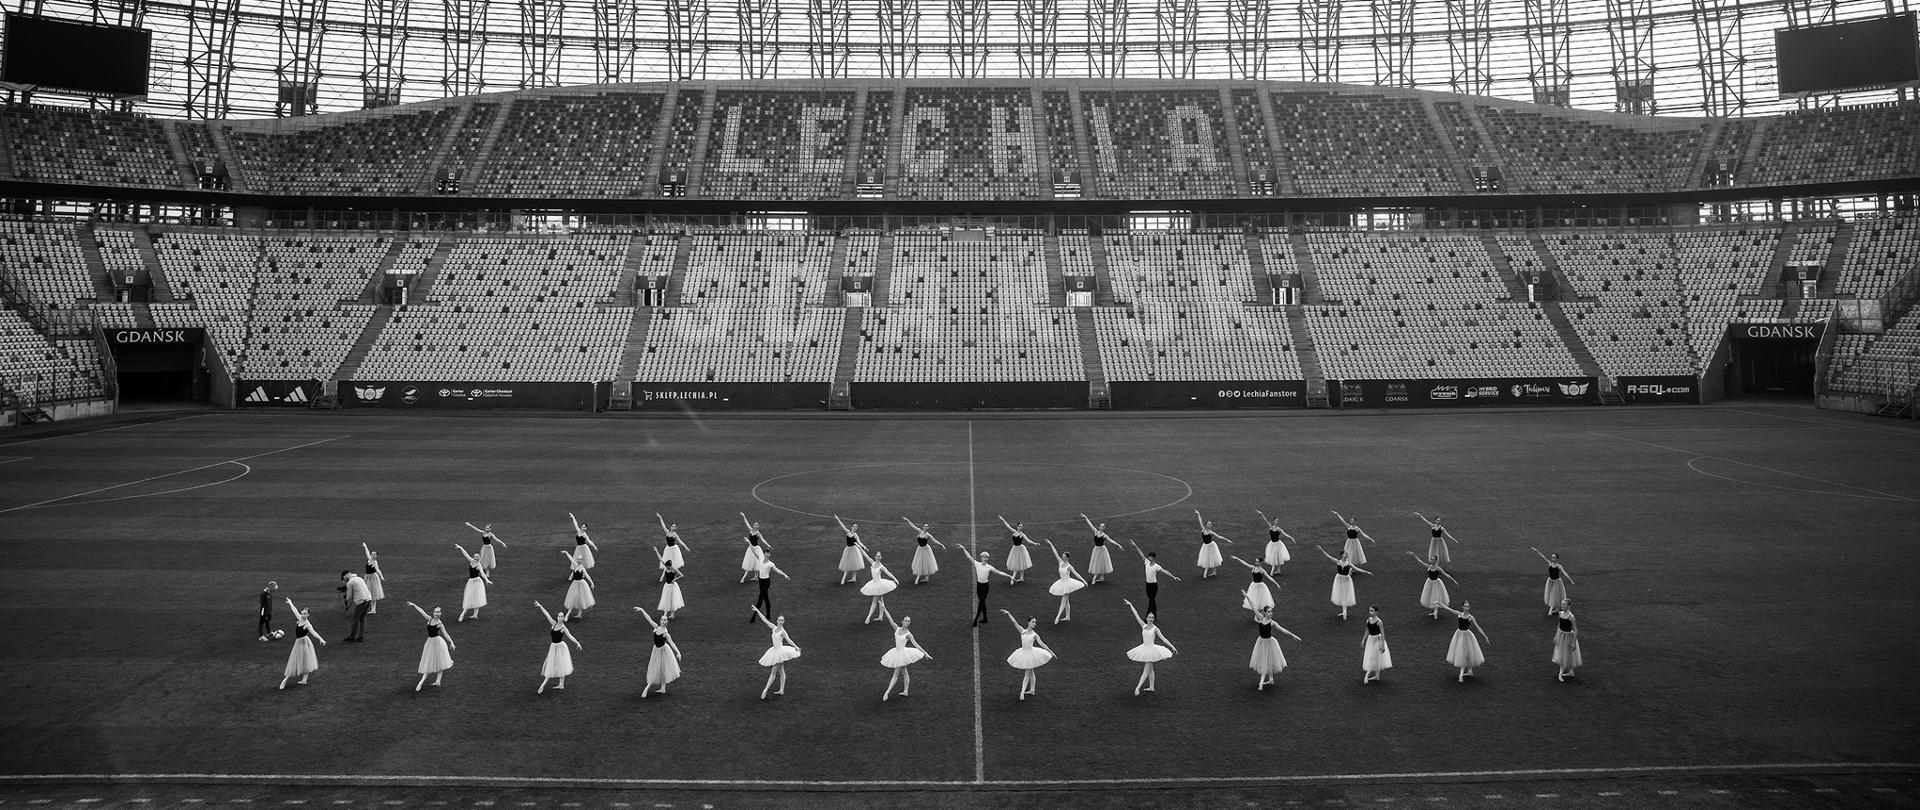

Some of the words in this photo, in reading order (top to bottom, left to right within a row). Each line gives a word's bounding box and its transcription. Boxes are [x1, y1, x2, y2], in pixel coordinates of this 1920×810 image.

[719, 103, 1219, 174] LECHIA
[116, 328, 185, 343] GDAŃSK
[1747, 323, 1816, 338] GDAŃSK
[655, 391, 718, 399] SKLEP.LECHIA.PL
[1243, 389, 1297, 398] LechiaFanstore
